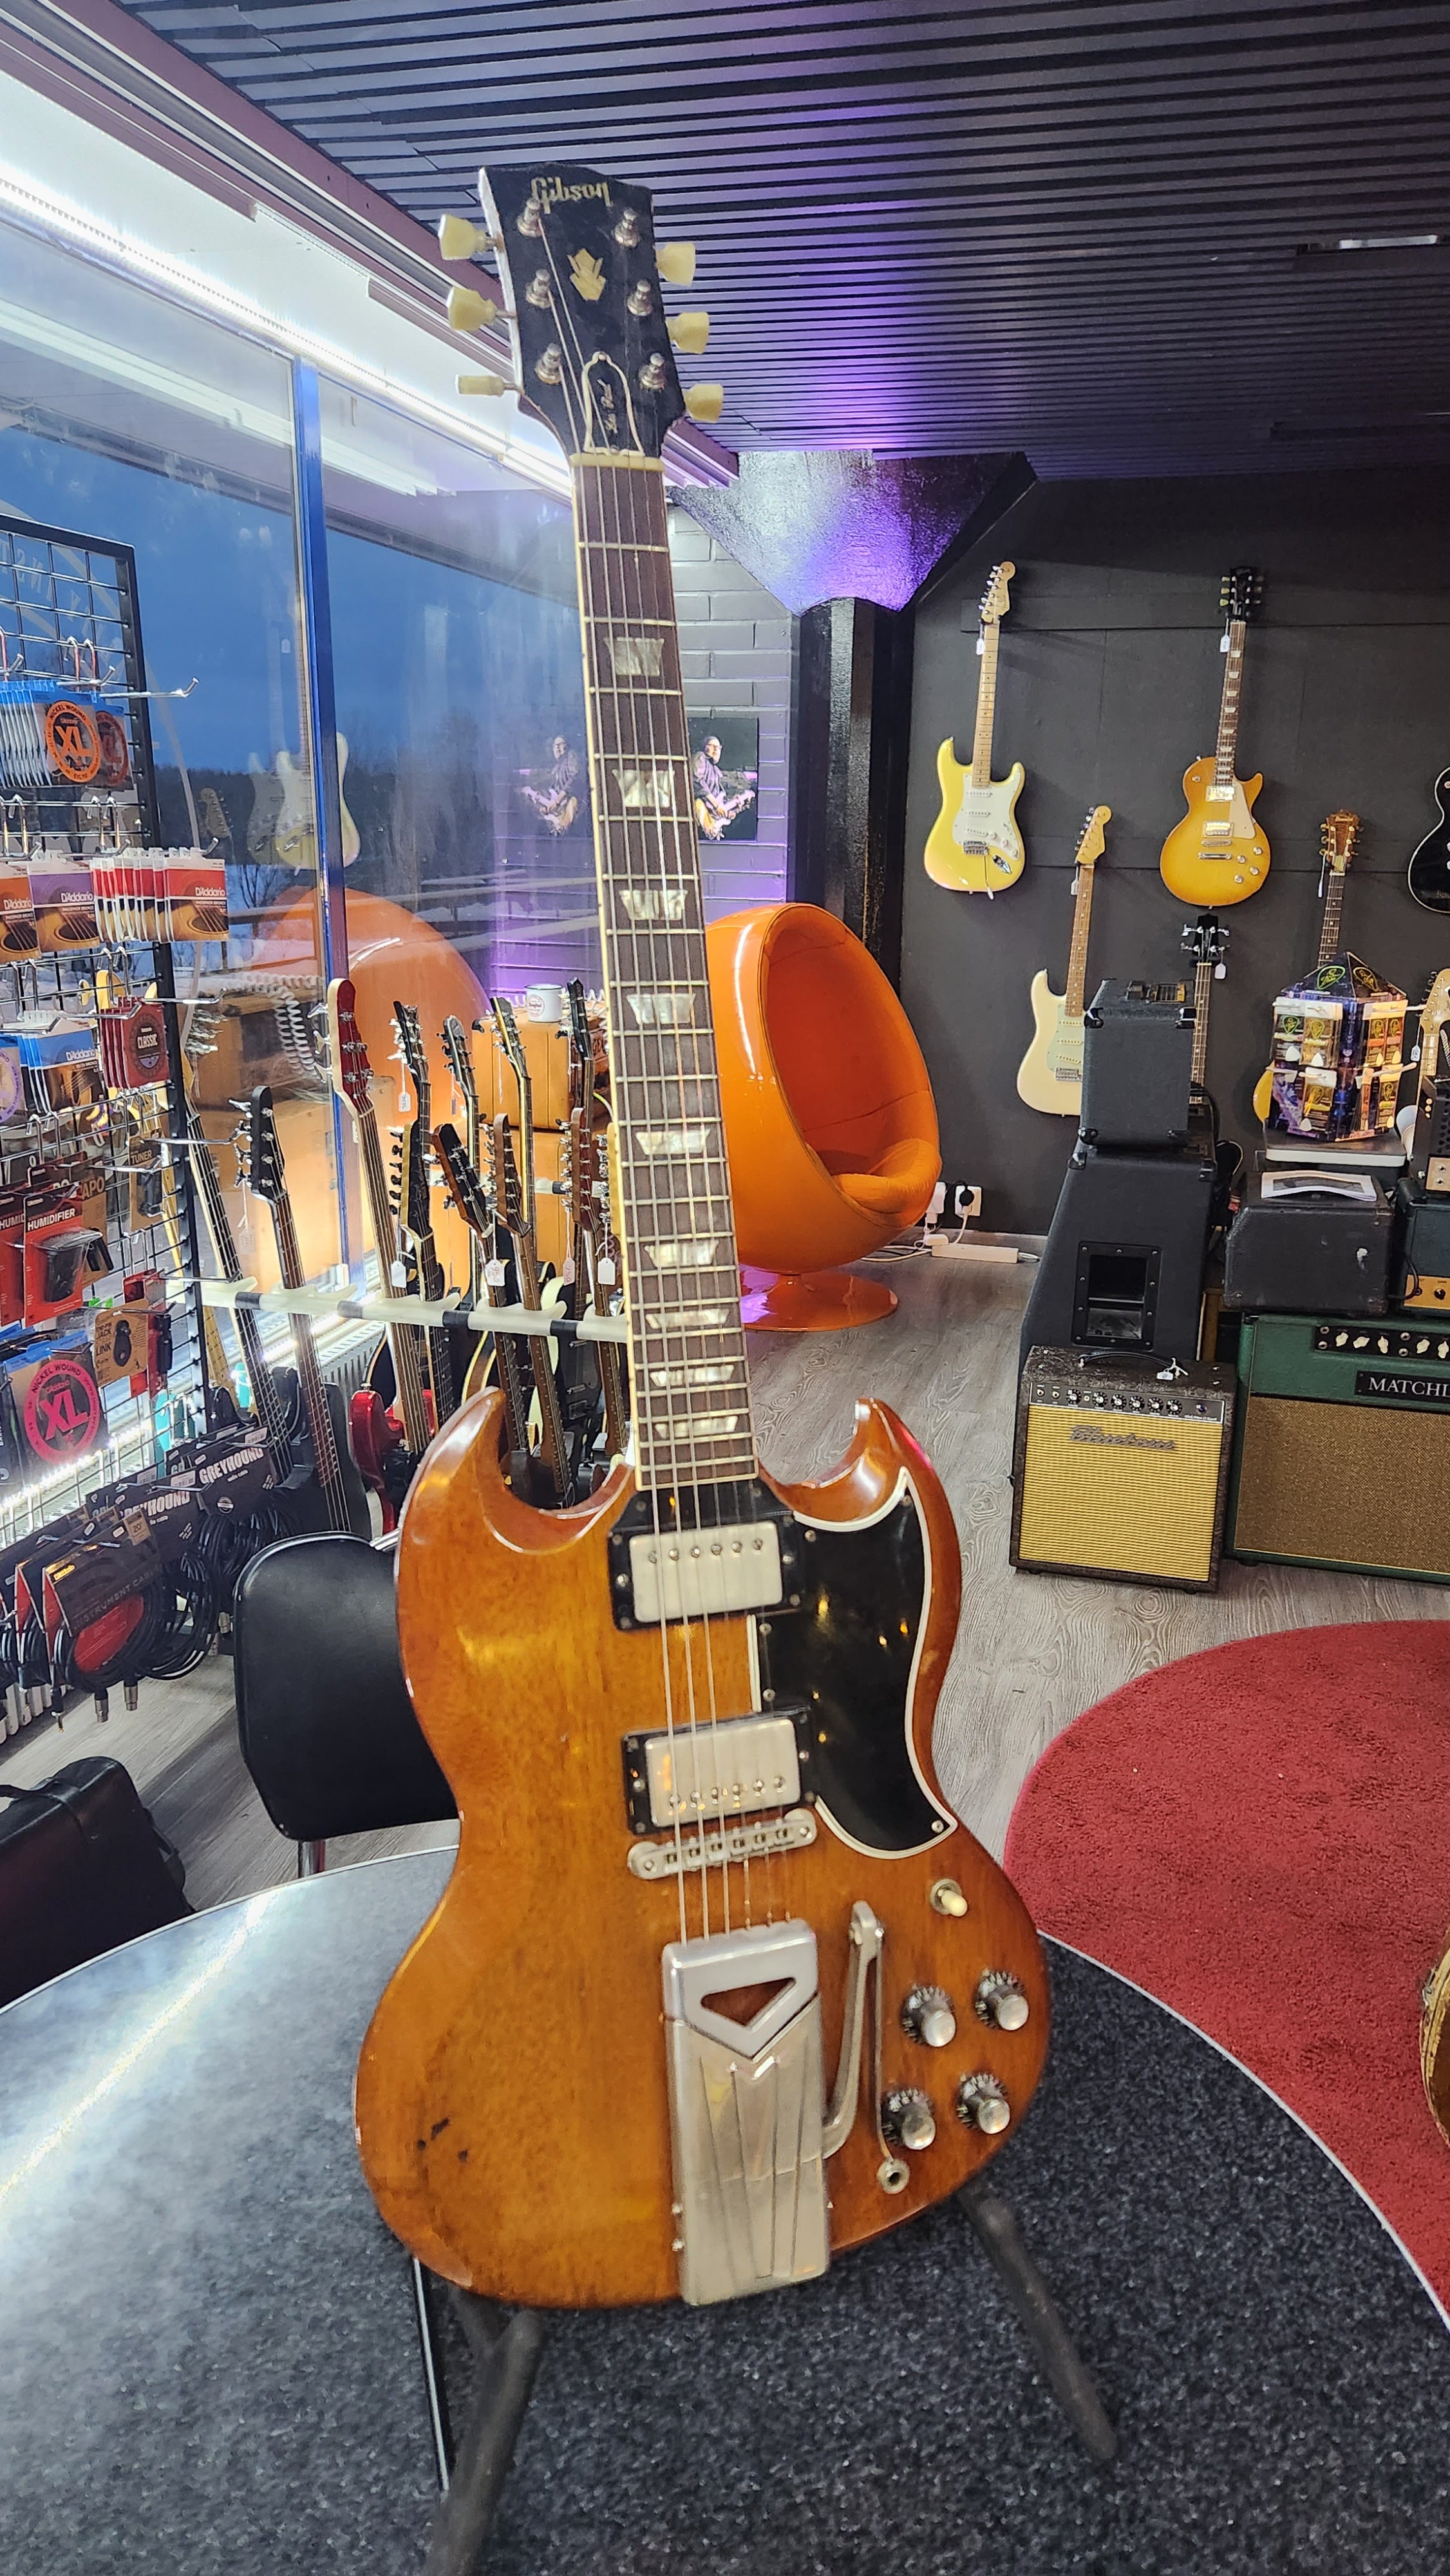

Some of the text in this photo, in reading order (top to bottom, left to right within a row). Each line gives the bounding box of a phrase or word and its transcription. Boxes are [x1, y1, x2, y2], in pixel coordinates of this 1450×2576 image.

[531, 176, 613, 214] Gibson
[50, 705, 66, 721] NICKEL
[55, 726, 93, 757] XL
[61, 891, 93, 902] D'Addario
[194, 886, 225, 897] D'Addario
[137, 1033, 158, 1049] CLASSIC
[66, 1048, 96, 1061] D'Addario
[130, 1149, 153, 1165] TUNER
[80, 1175, 106, 1200] APO
[26, 1208, 76, 1231] HUMIDIFIER
[32, 1368, 53, 1394] NICKEL
[54, 1363, 81, 1376] WOUND
[1368, 1376, 1450, 1397] MATCHL
[39, 1388, 89, 1441] XL
[198, 1446, 265, 1485] GREYHOUND
[73, 1584, 131, 1630] STRUMENT
